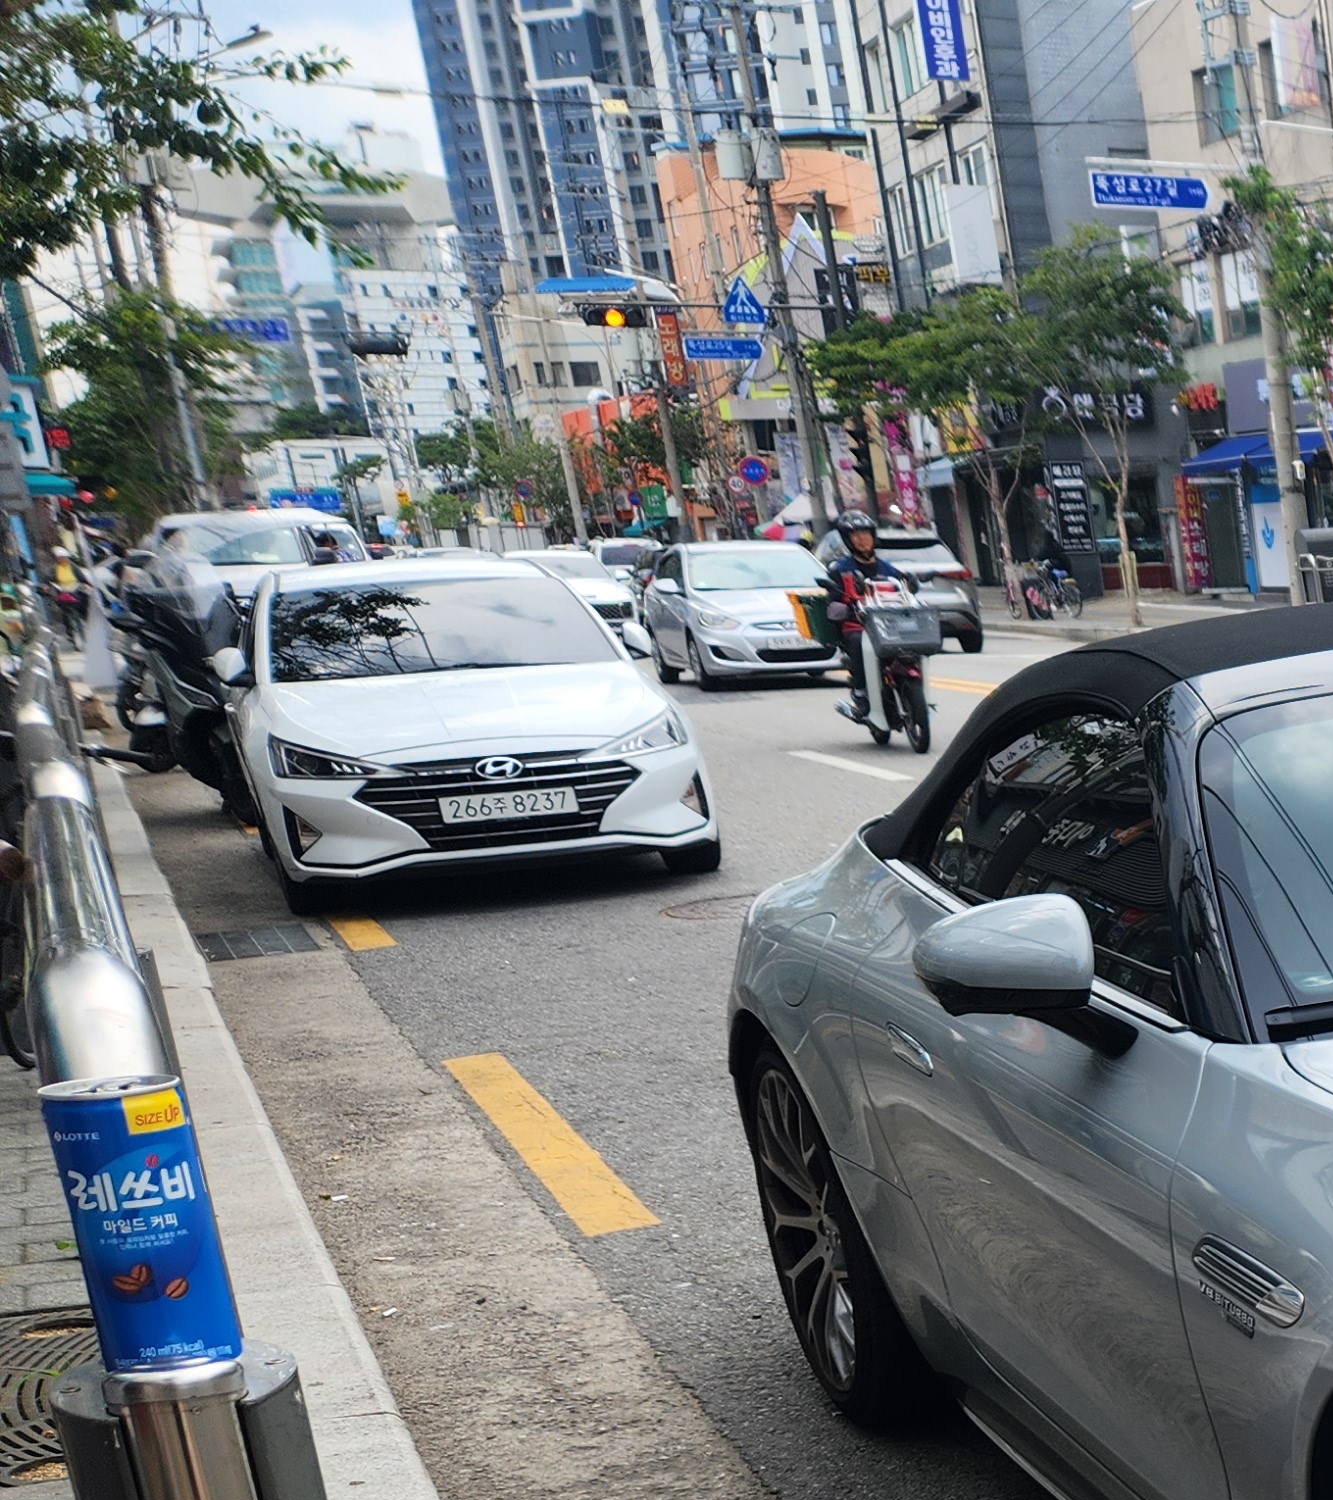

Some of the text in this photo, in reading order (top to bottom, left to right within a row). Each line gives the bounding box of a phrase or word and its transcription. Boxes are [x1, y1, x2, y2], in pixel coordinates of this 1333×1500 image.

[449, 790, 566, 819] 266주 8237
[135, 1103, 180, 1127] SIZE UP
[62, 1131, 100, 1141] LOTTE
[67, 1161, 197, 1213] 레쓰비
[103, 1213, 179, 1235] 마일드 커피
[139, 1347, 157, 1358] 240
